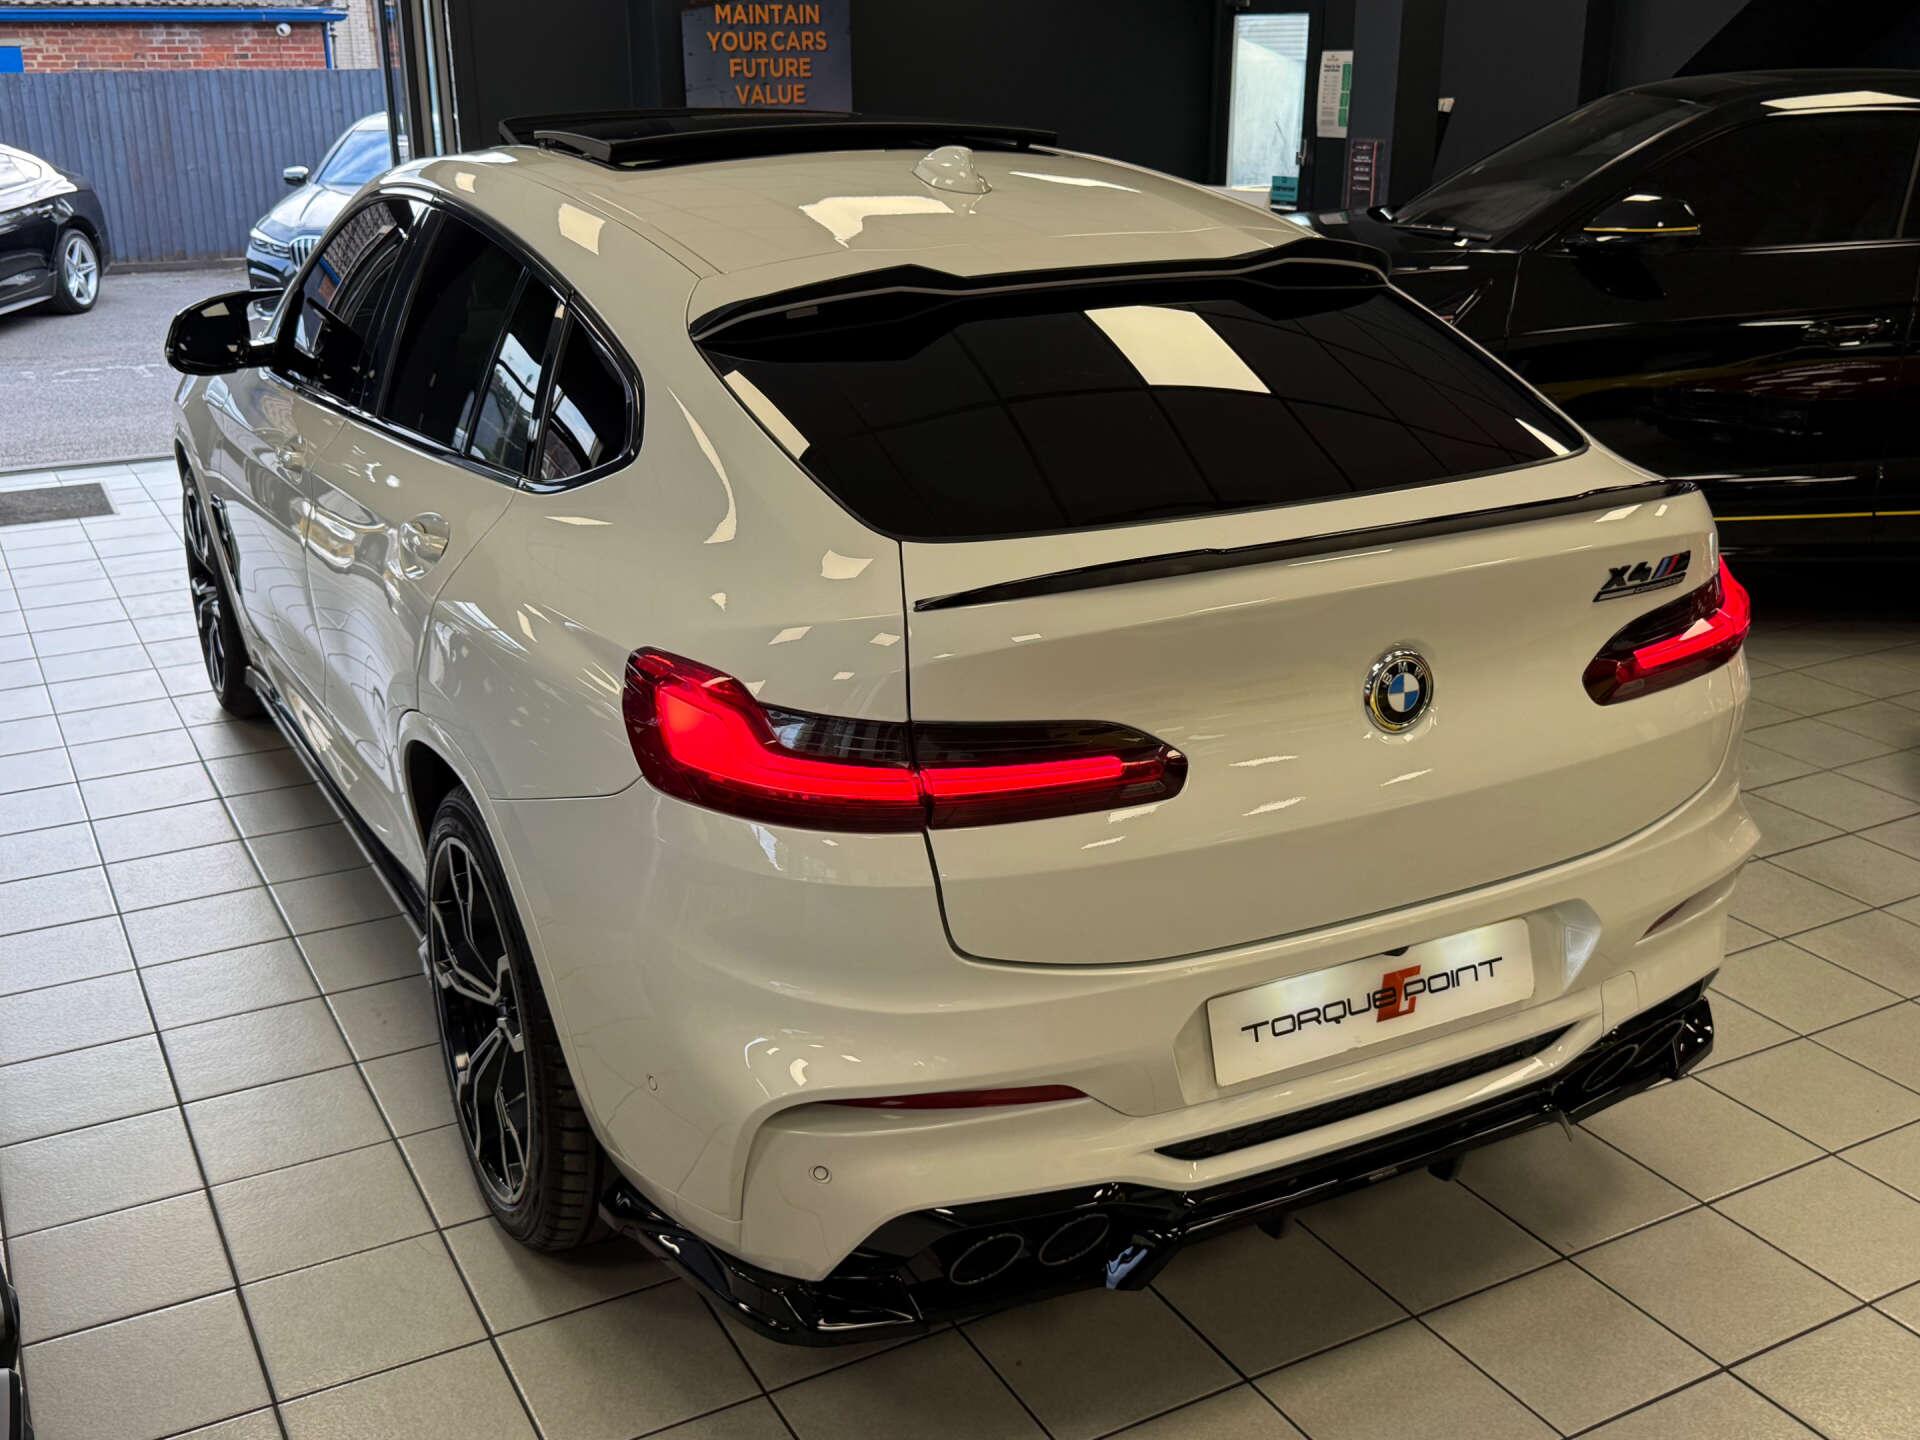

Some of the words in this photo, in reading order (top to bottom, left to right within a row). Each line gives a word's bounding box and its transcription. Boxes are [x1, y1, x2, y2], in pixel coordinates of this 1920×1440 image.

[714, 3, 820, 25] MAINTAIN
[706, 30, 767, 52] YOUR
[770, 31, 828, 51] CARS
[728, 57, 813, 78] FUTURE
[735, 83, 807, 105] VALUE
[1382, 661, 1424, 686] BMW
